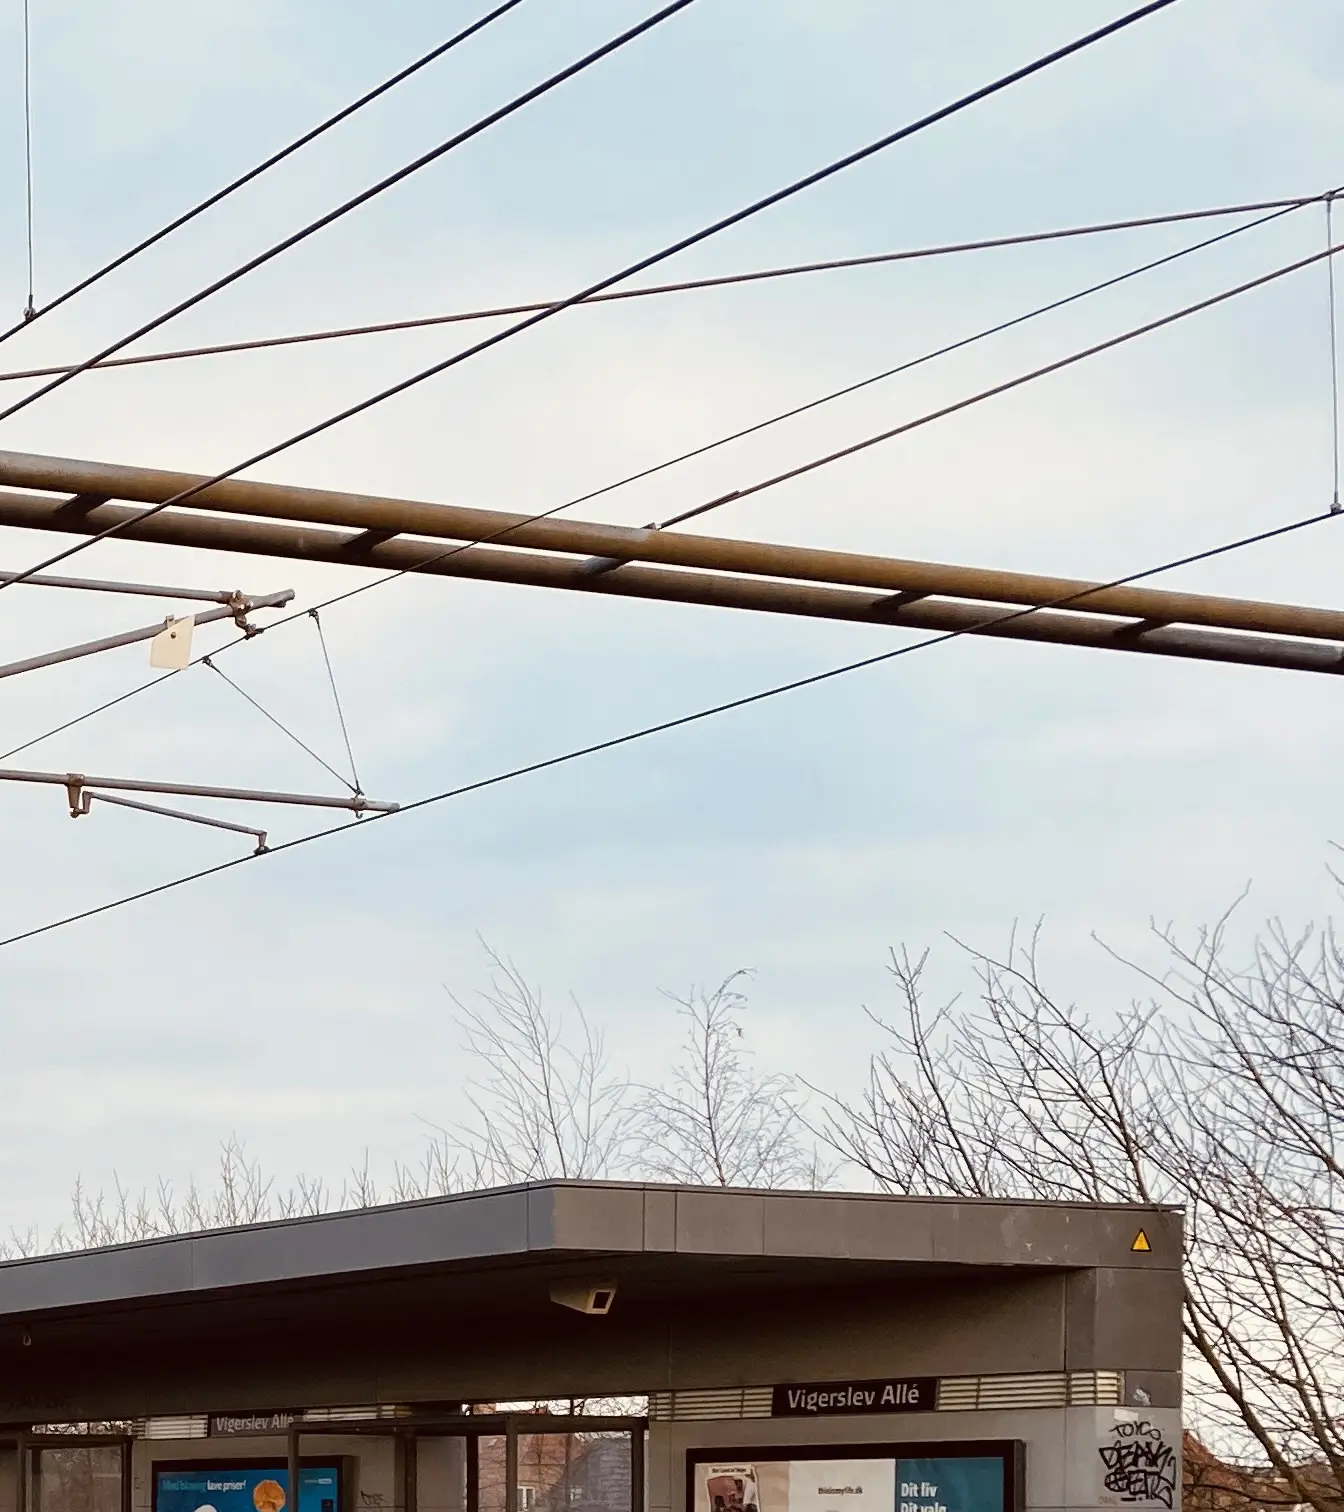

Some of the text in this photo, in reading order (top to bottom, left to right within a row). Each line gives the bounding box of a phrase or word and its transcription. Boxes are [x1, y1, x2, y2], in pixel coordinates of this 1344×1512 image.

[787, 1383, 920, 1412] Vigerslev Allé
[216, 1413, 270, 1433] Vigerslev
[900, 1481, 938, 1498] Dit liv
